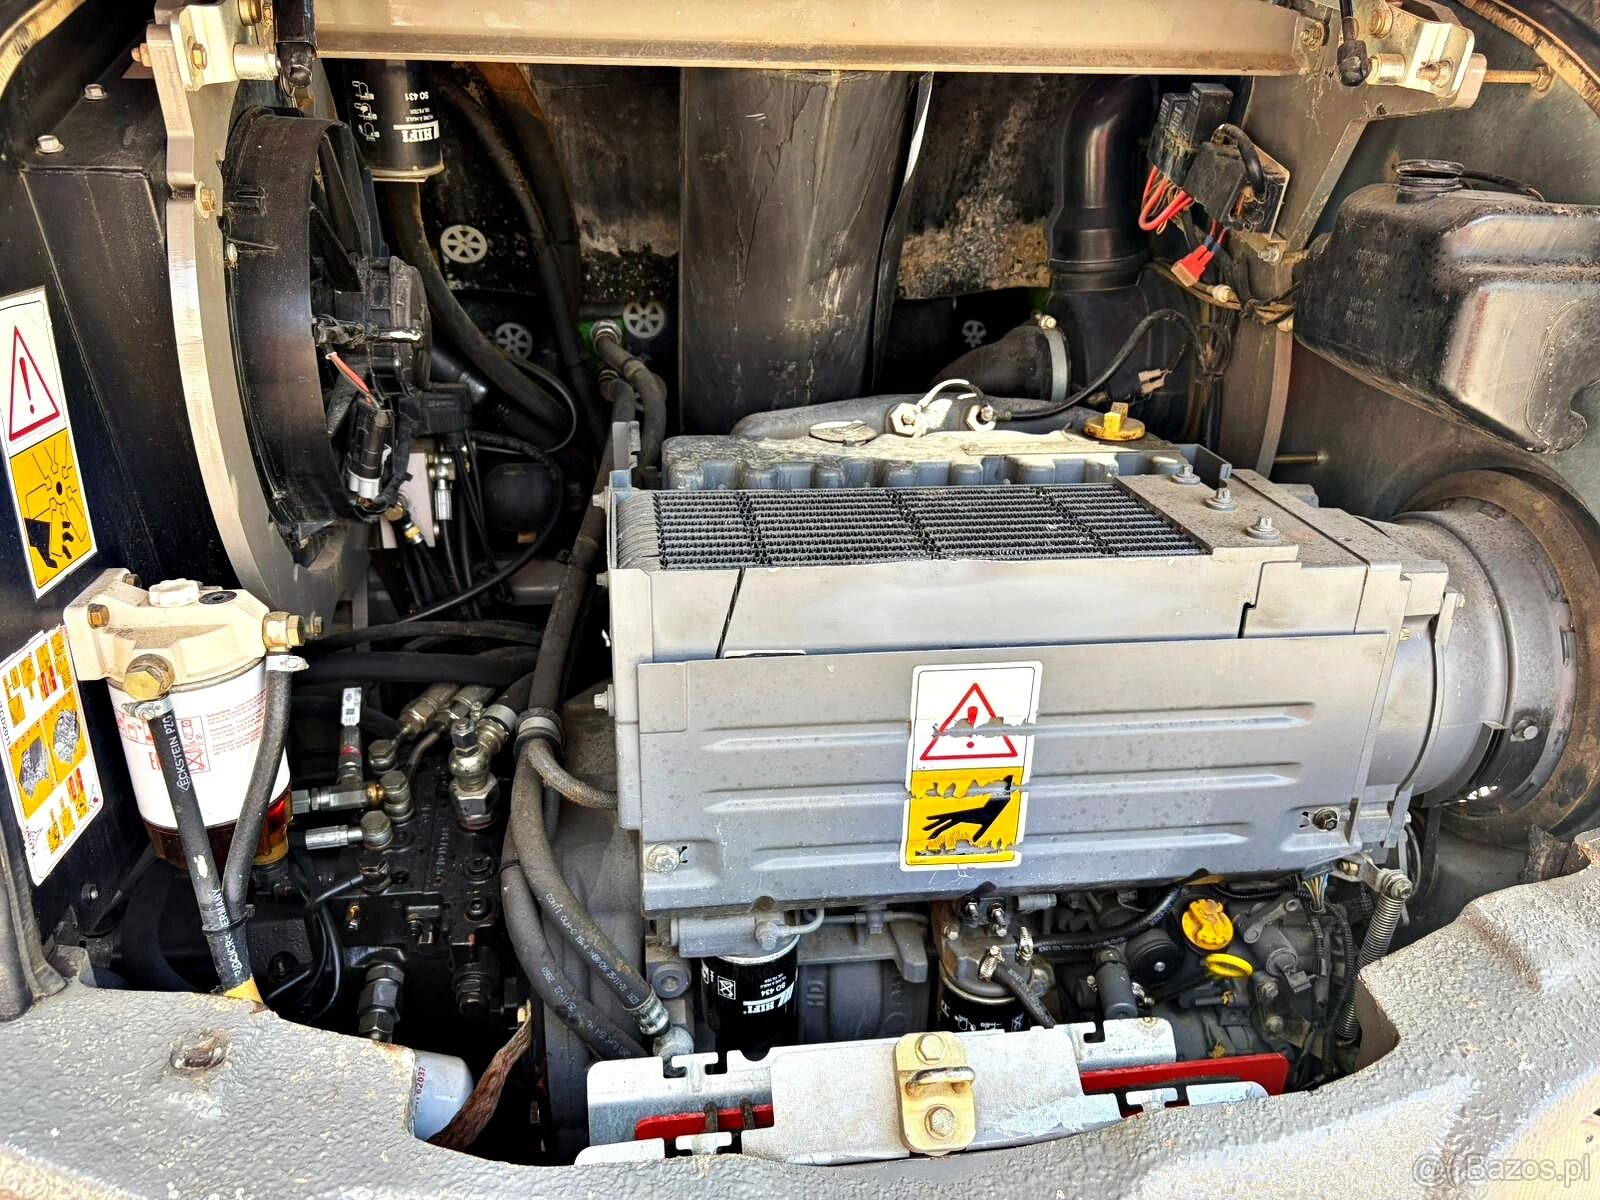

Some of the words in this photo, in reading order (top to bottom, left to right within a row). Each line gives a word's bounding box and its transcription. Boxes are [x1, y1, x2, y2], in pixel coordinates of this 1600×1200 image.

[404, 92, 419, 101] 431
[401, 128, 433, 142] HIFI
[168, 735, 190, 788] ECKSTEIN
[211, 888, 230, 928] ERMANY
[760, 988, 775, 997] 434
